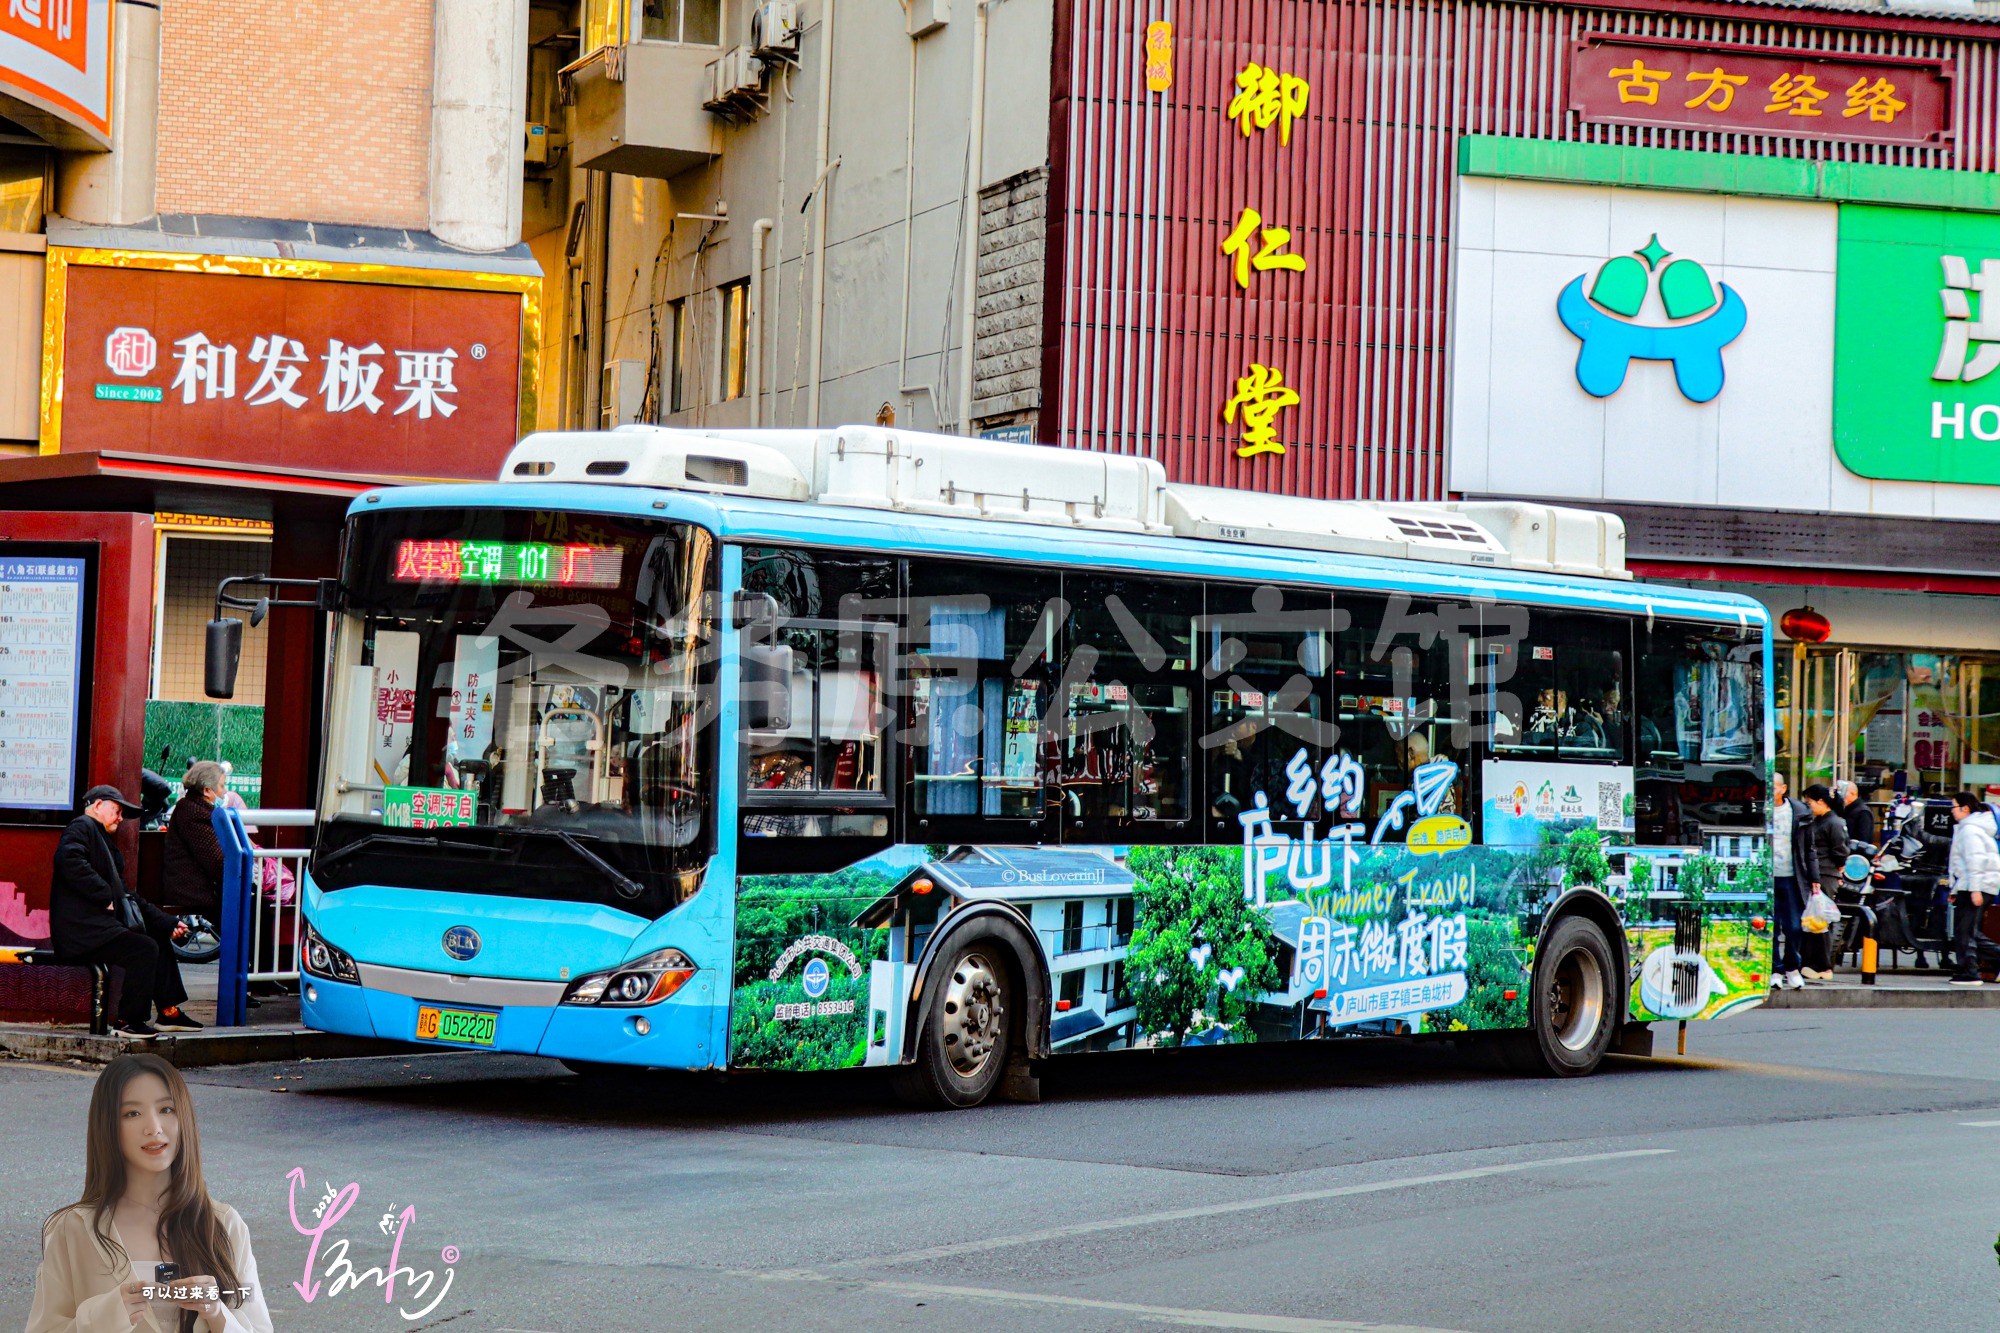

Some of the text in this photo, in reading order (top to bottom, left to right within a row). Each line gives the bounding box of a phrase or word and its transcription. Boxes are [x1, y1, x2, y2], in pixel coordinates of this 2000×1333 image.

[1148, 28, 1171, 84] 京城
[1608, 58, 1907, 123] 古方经络
[1222, 62, 1310, 458] 御仁堂
[96, 385, 163, 401] Since 2002
[171, 331, 459, 420] 和发板栗
[517, 546, 549, 579] 101
[463, 673, 479, 739] 防止夹伤
[412, 791, 472, 818] 空调开启
[1285, 747, 1365, 818] 乡约
[1238, 790, 1366, 908] 庐山下
[1301, 862, 1475, 925] Summer Travel
[449, 934, 474, 950] BLK
[769, 935, 863, 984] 九江市公共交通集团公司
[1293, 909, 1468, 998] 周末微度假
